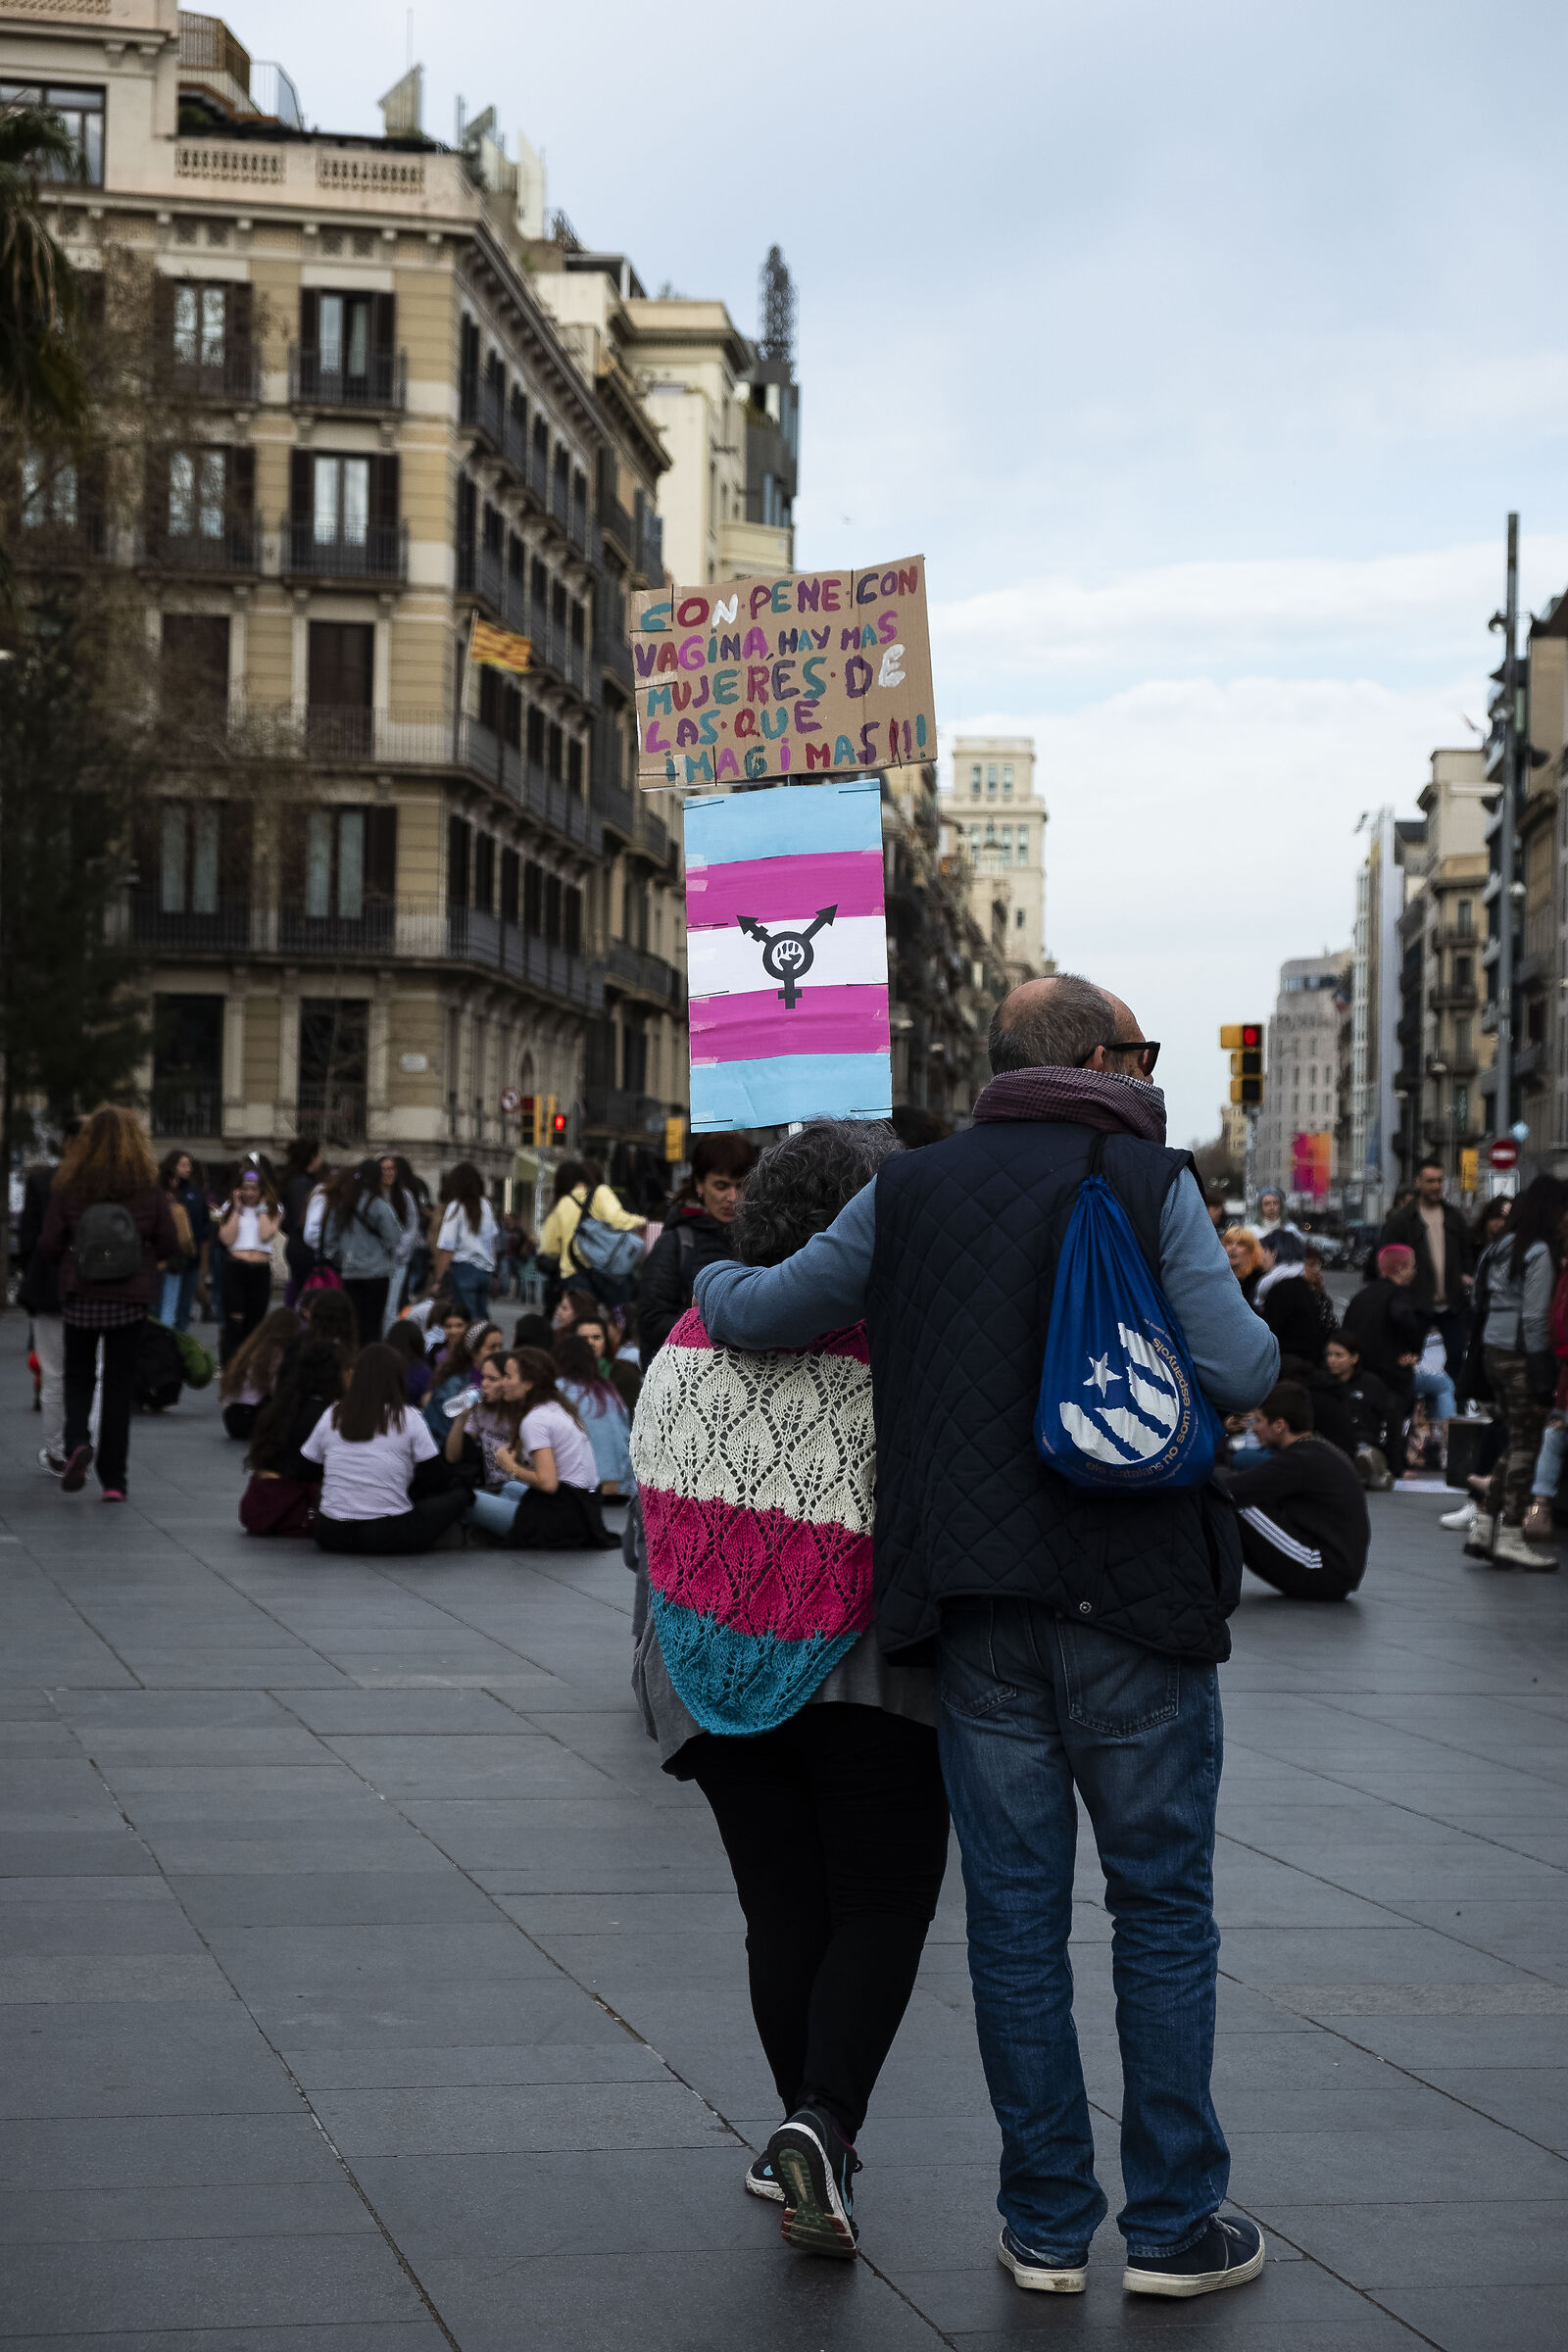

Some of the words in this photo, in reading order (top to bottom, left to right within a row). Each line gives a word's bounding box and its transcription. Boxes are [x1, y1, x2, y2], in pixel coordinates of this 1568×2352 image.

[640, 593, 739, 632] CON
[750, 578, 842, 619] PENE
[857, 565, 918, 605] CON
[778, 625, 831, 656] HAY
[840, 610, 898, 651] MAS
[647, 656, 828, 716] MUJERES
[845, 643, 906, 699] DE
[645, 710, 721, 753] LAS
[734, 700, 823, 740] QUE
[1152, 1337, 1191, 1407] espanyols
[1176, 1409, 1191, 1444] som
[1110, 1461, 1164, 1479] catalans
[1162, 1445, 1180, 1466] no
